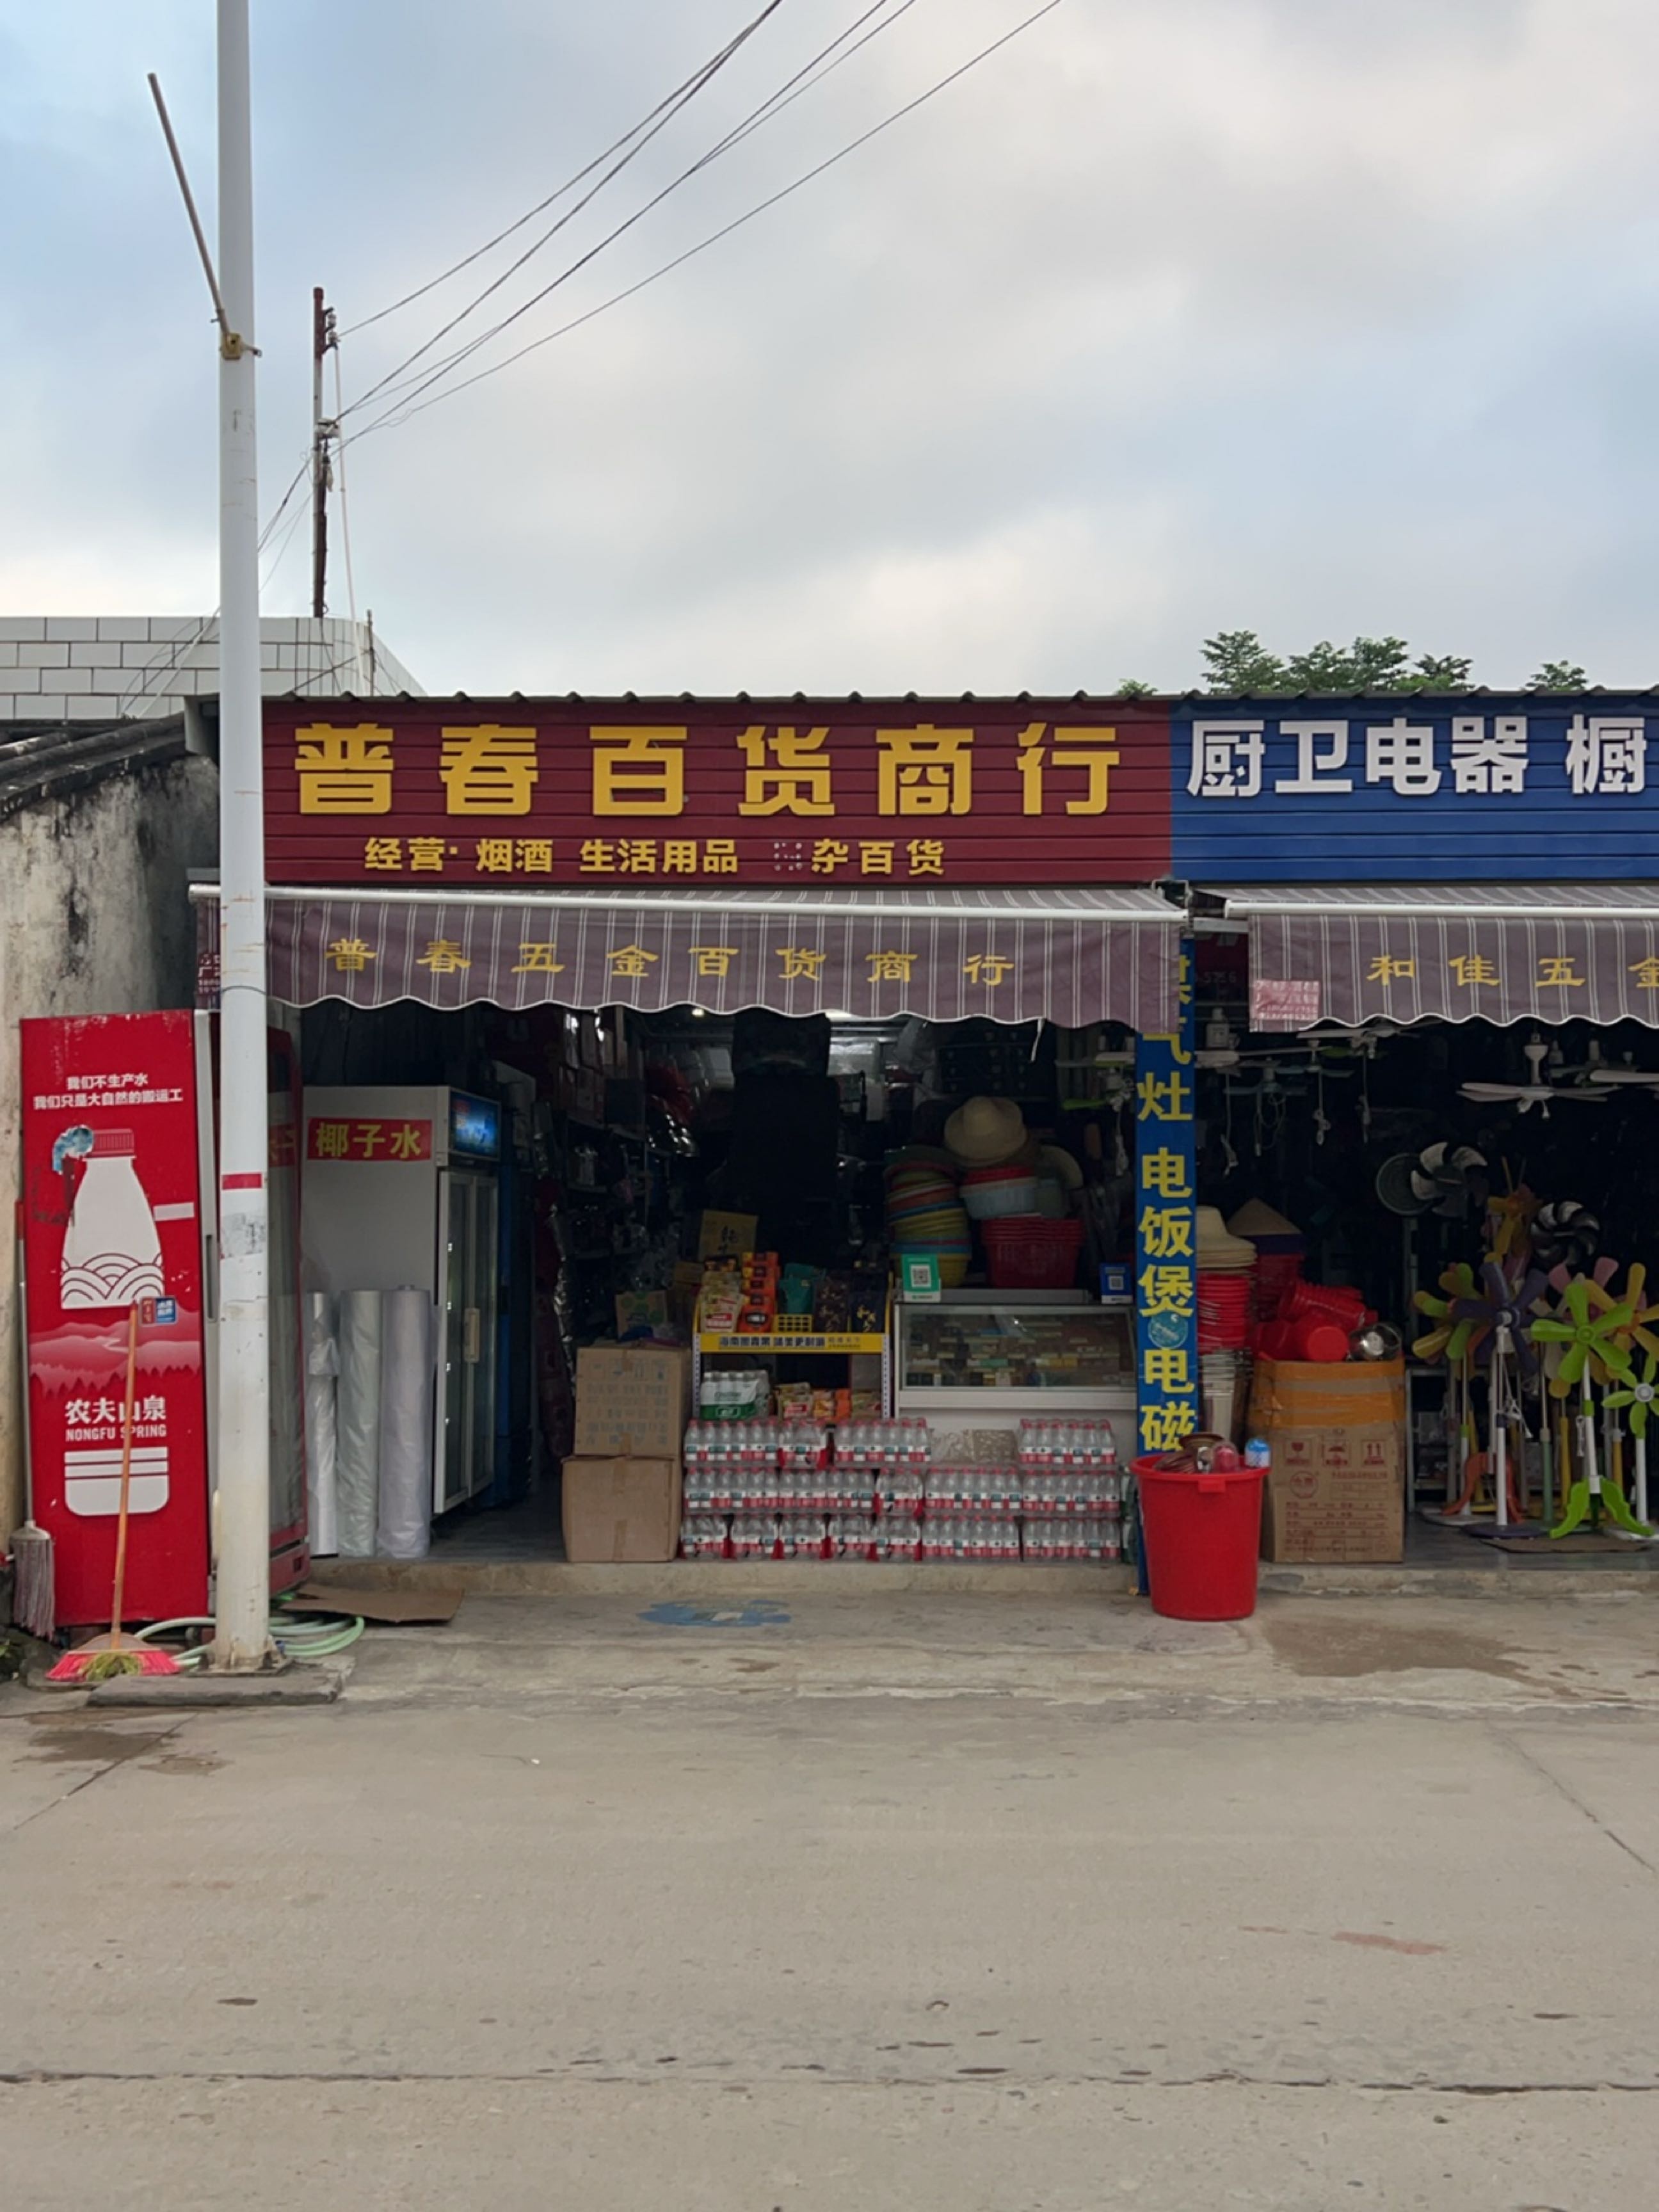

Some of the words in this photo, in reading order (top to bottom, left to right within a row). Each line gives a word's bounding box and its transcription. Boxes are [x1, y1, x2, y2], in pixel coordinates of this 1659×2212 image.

[294, 723, 1119, 816] 普春百货商行
[1187, 716, 1529, 797] 厨卫电器
[1566, 715, 1647, 794] 橱
[476, 838, 554, 872] 烟酒
[579, 838, 738, 873] 生活用品
[325, 938, 1014, 987] 普春五金百货商行
[1366, 954, 1659, 989] 和佳五金
[33, 1088, 183, 1110] 我们只是大自然的搬运工
[67, 1073, 148, 1090] 我们不生产水
[316, 1123, 422, 1159] 椰子水
[65, 1395, 166, 1425] 农夫山泉
[65, 1427, 116, 1442] NONGFU
